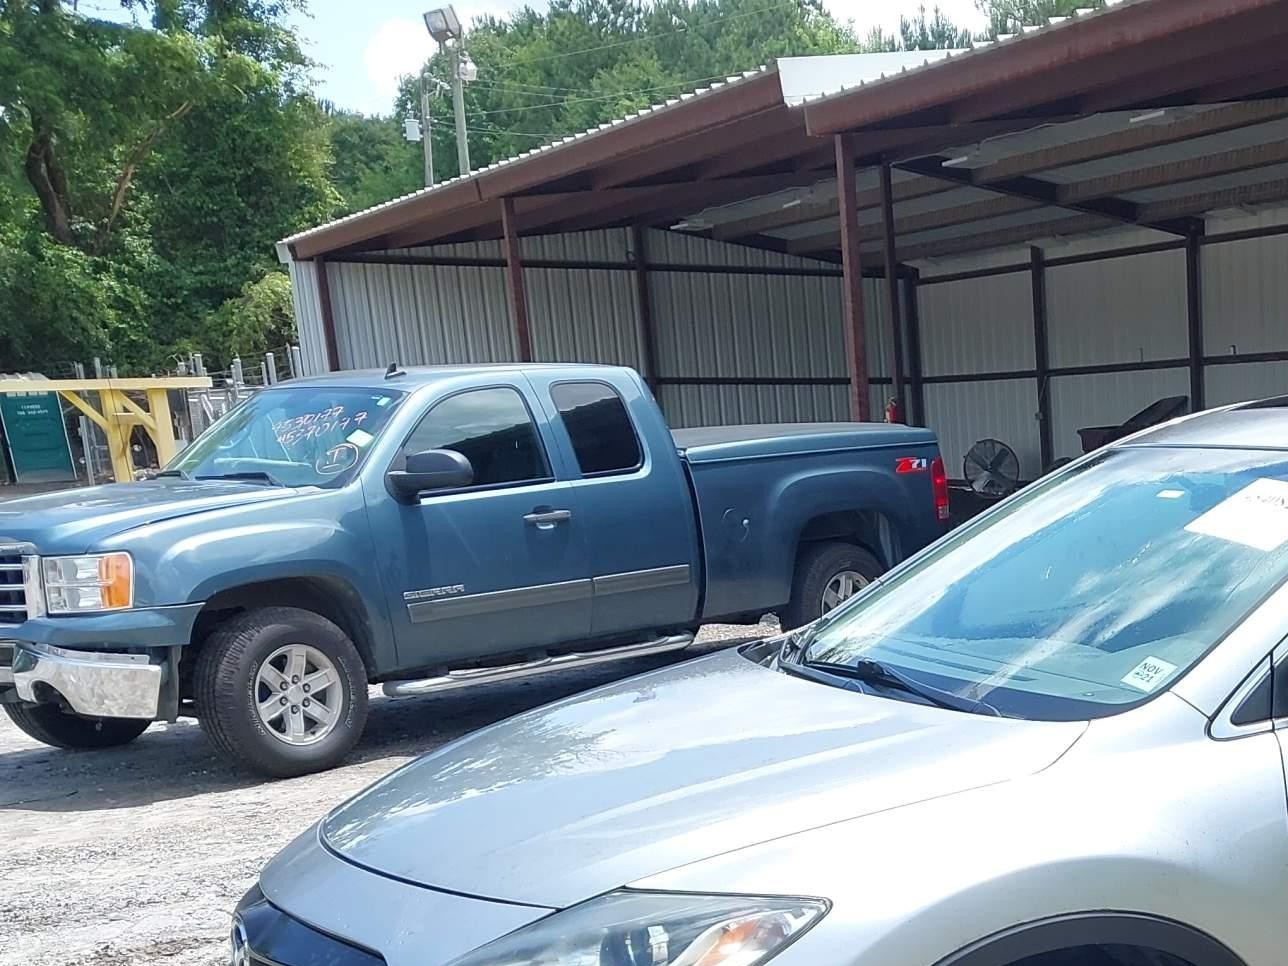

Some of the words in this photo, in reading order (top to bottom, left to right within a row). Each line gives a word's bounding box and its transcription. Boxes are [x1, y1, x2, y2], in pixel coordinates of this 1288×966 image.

[895, 456, 927, 473] Z71
[403, 584, 465, 600] SIERRA
[1139, 662, 1164, 675] NOV
